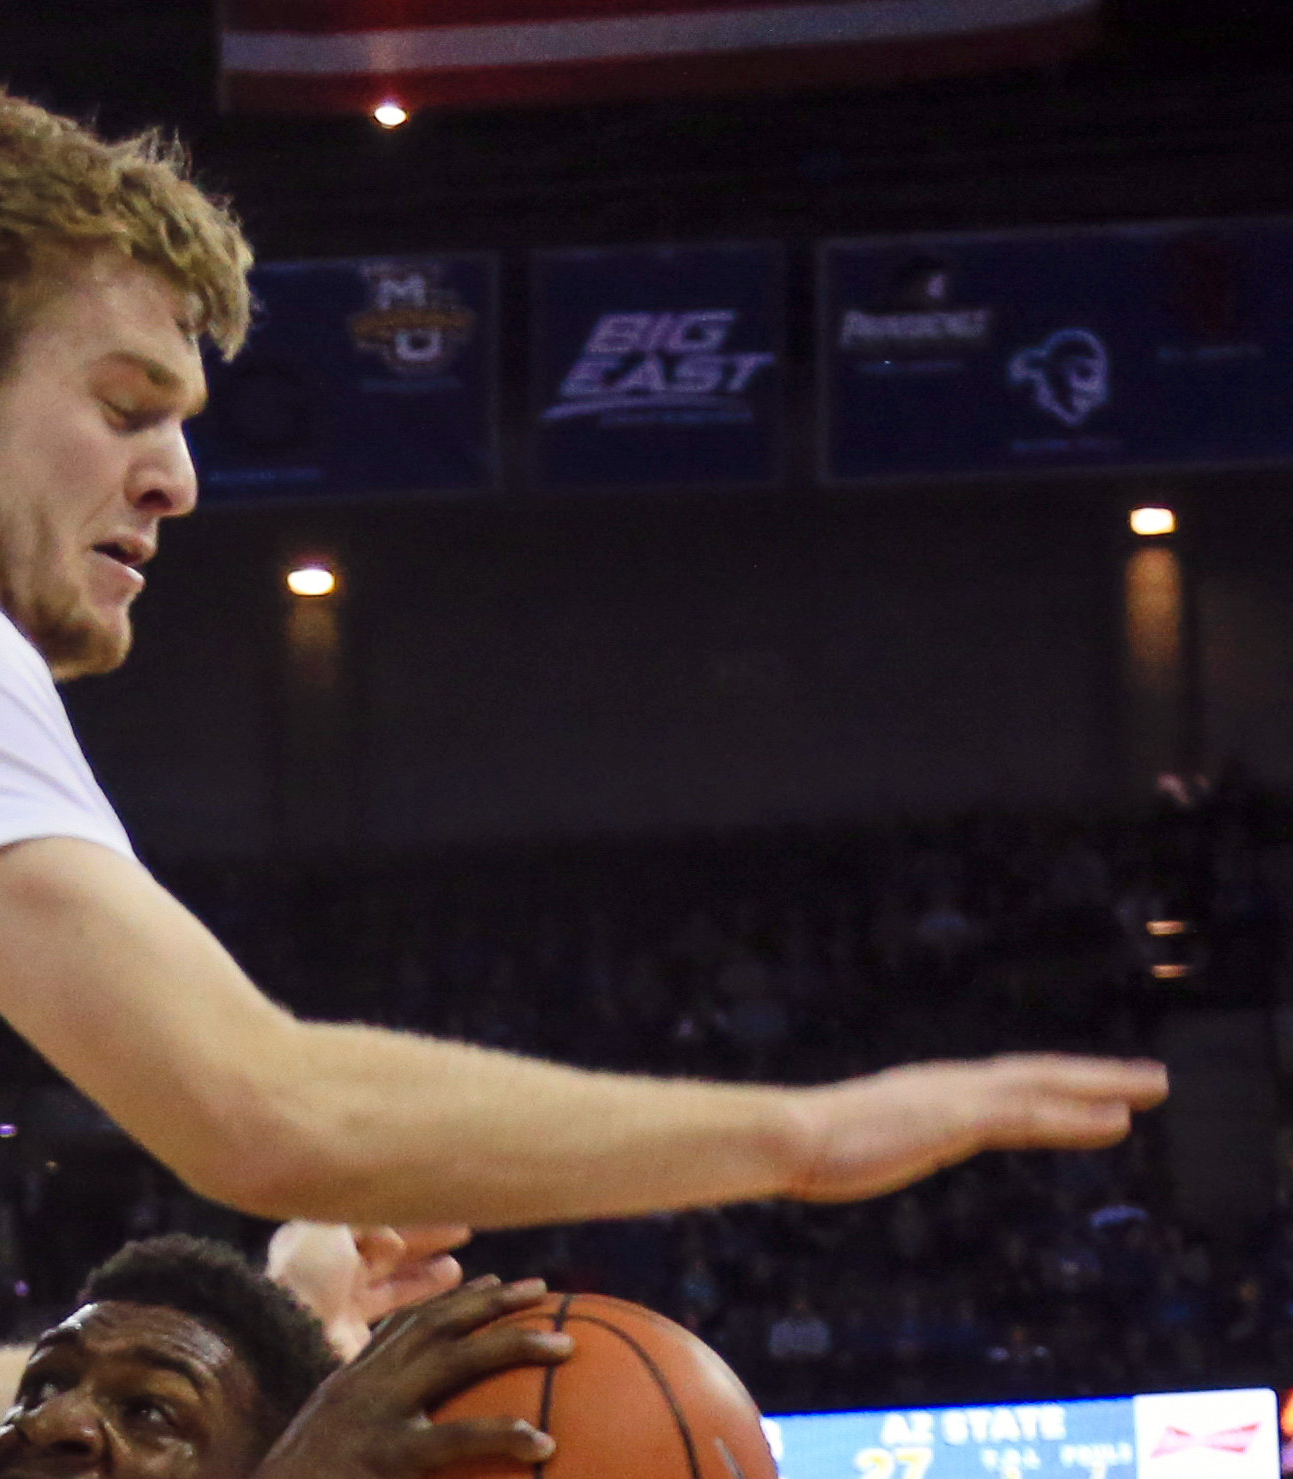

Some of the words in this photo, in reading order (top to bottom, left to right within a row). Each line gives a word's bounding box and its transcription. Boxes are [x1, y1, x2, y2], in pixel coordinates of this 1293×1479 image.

[583, 309, 735, 353] BIG
[559, 353, 775, 397] EAST
[941, 1405, 1066, 1445] STATE
